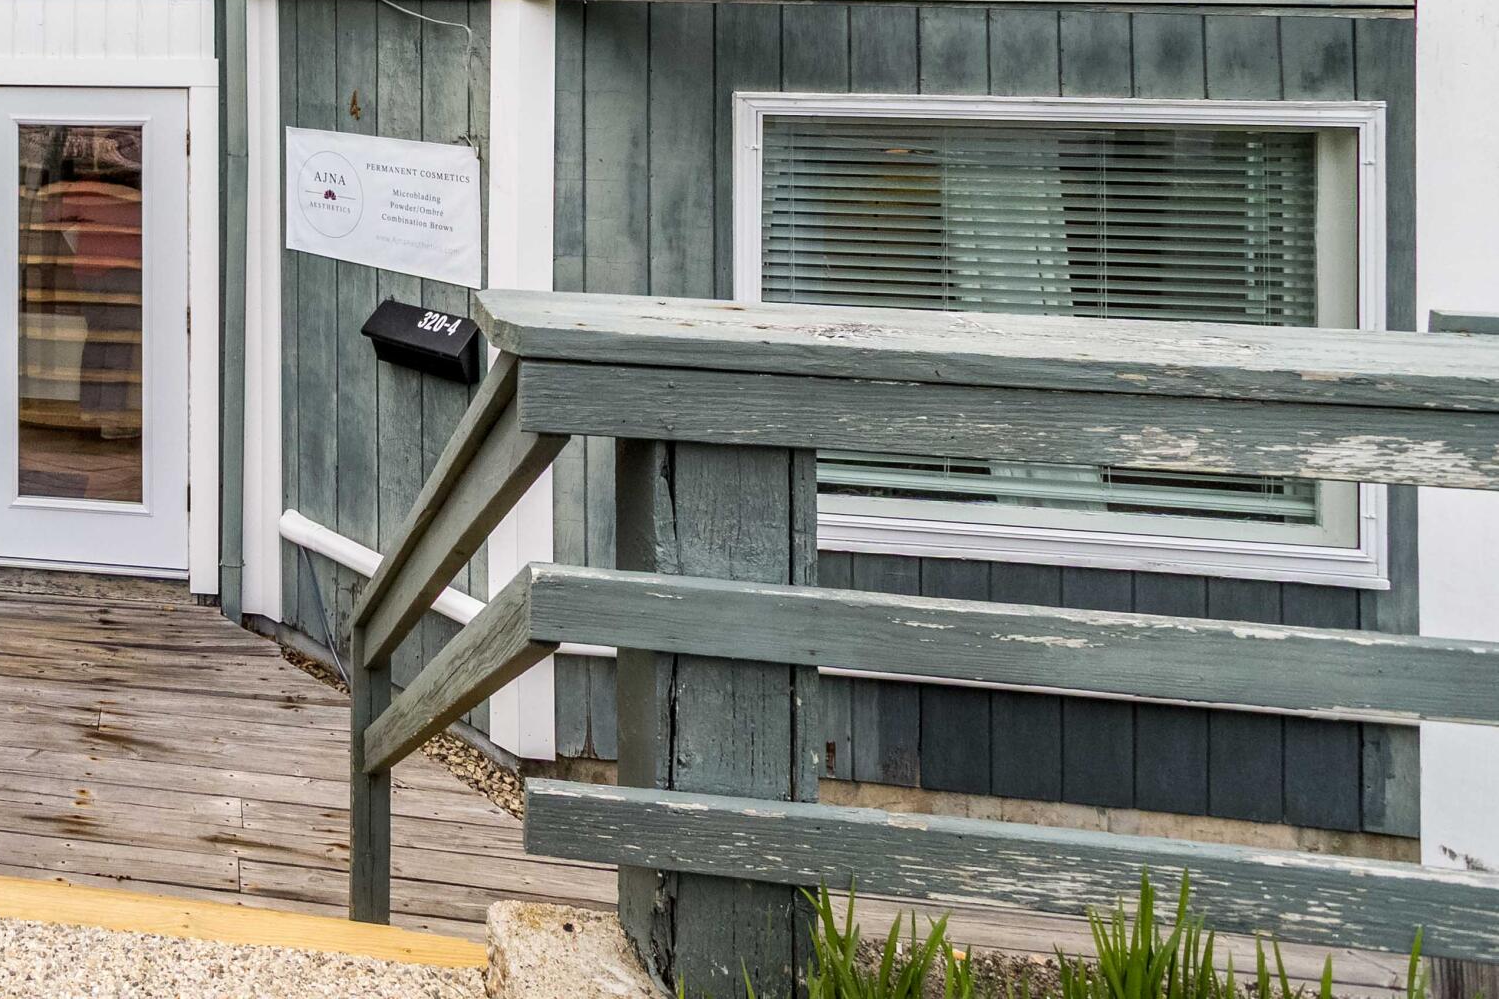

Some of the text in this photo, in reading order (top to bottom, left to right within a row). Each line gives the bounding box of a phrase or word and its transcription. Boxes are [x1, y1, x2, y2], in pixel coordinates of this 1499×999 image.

[313, 171, 346, 186] AJNA
[366, 163, 470, 183] PERMANENT COSMETICS
[392, 189, 441, 204] Microblading
[309, 200, 351, 214] AESTHETICS
[381, 213, 427, 228] Combination
[417, 311, 462, 336] 320-4
